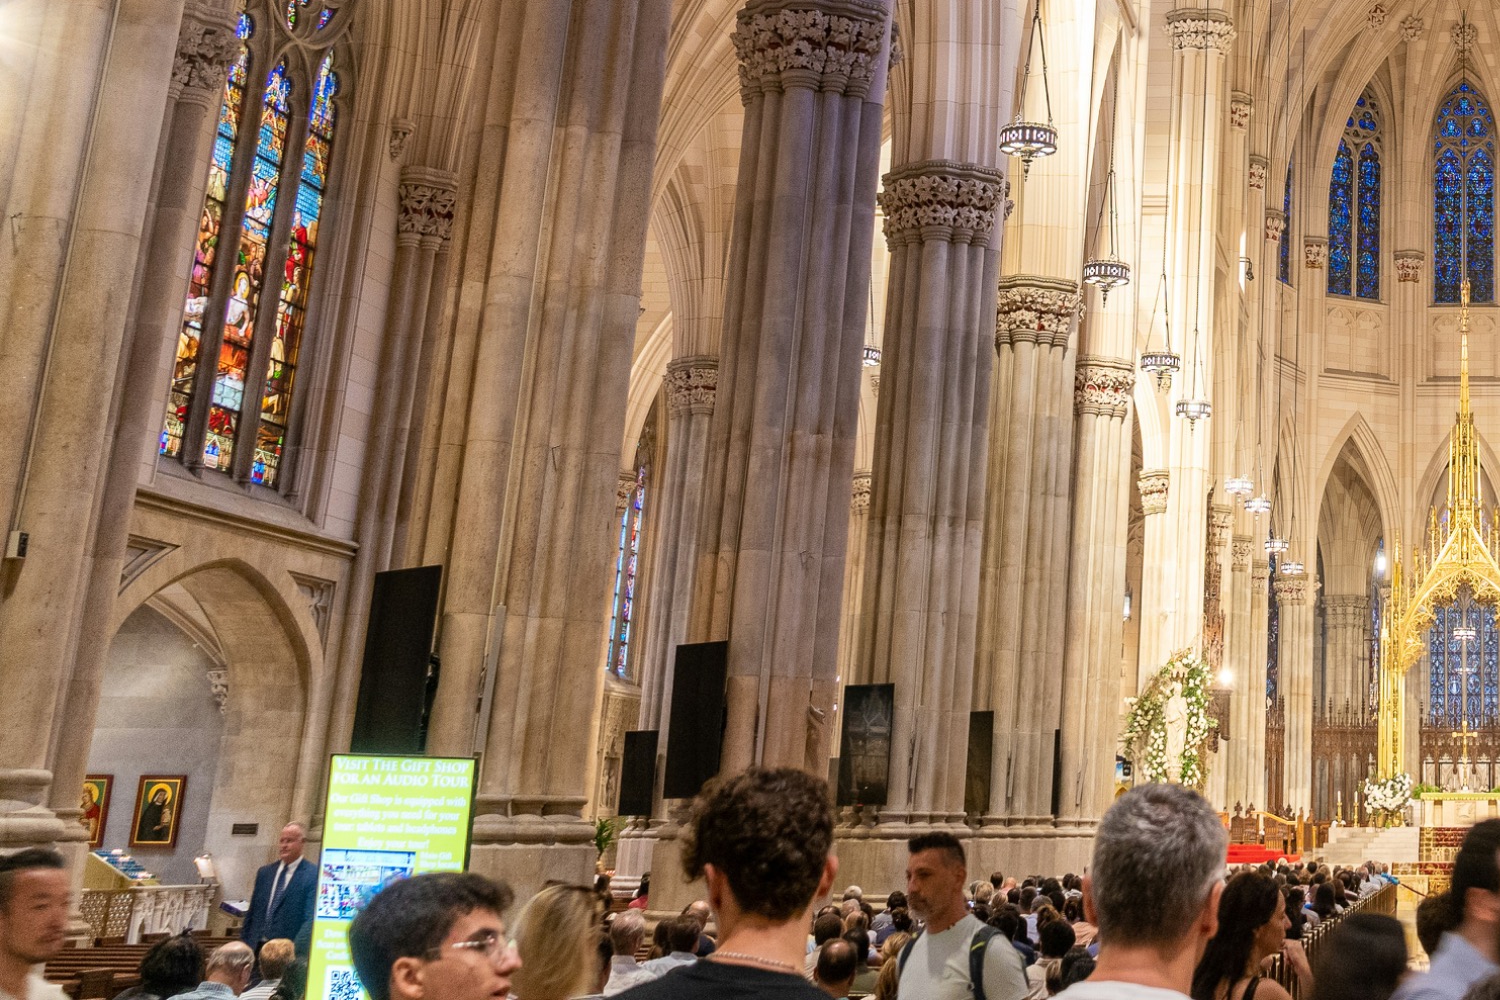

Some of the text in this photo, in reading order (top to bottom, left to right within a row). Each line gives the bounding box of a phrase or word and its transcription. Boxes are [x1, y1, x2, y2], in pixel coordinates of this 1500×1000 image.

[400, 760, 431, 772] GIFT
[383, 774, 428, 786] AUDIO
[432, 775, 468, 787] TOUR
[350, 793, 368, 804] Gift
[370, 794, 392, 806] Shop
[394, 795, 402, 804] is
[404, 796, 444, 808] equipped
[446, 797, 466, 807] with
[334, 808, 459, 822] everything you need for your
[387, 823, 403, 833] and
[405, 824, 456, 836] headphones
